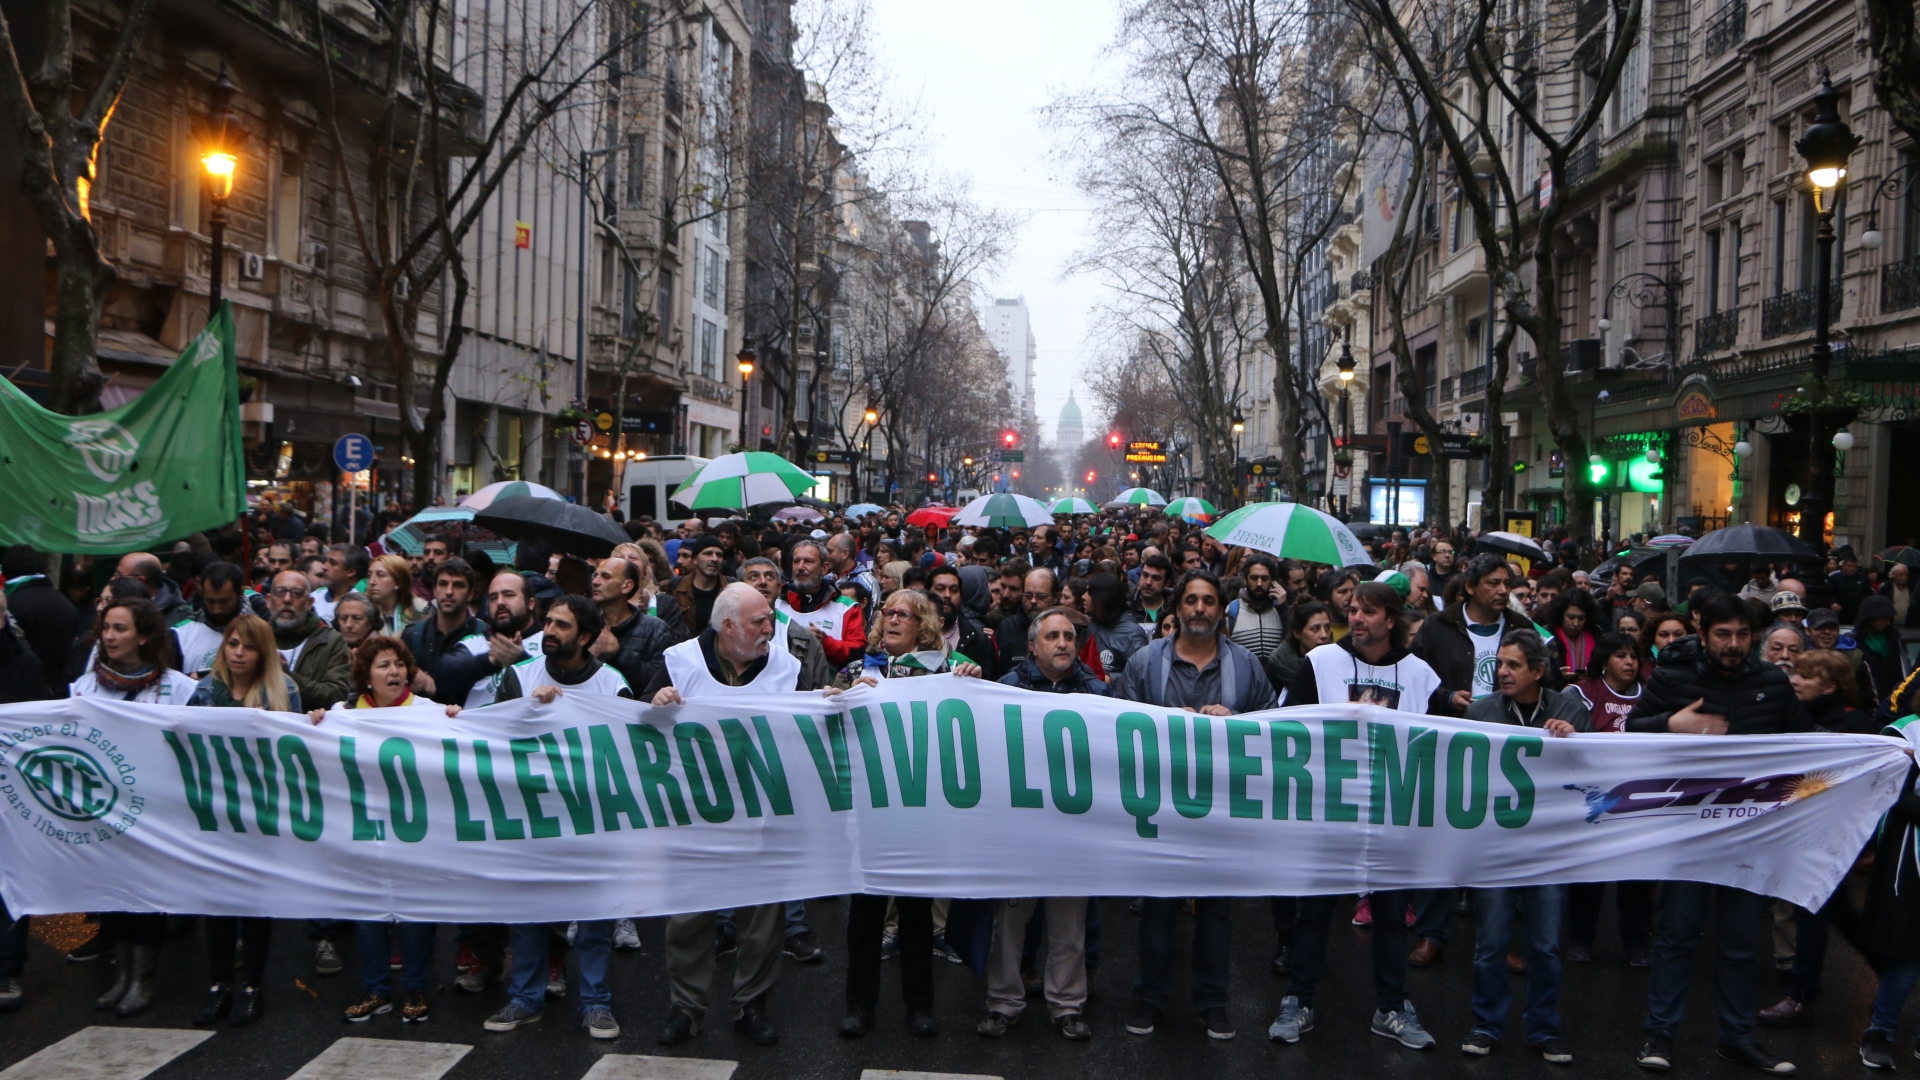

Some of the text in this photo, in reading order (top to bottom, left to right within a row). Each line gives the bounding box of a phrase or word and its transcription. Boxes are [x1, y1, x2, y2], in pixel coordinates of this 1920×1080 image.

[346, 438, 362, 459] E
[1233, 535, 1272, 549] CULTURA
[60, 721, 80, 738] el
[165, 699, 1543, 842] VIVO LO LLEVARON VIVO LO QUEREMOS
[0, 783, 145, 845] para liberar la ación
[1700, 808, 1722, 819] DE
